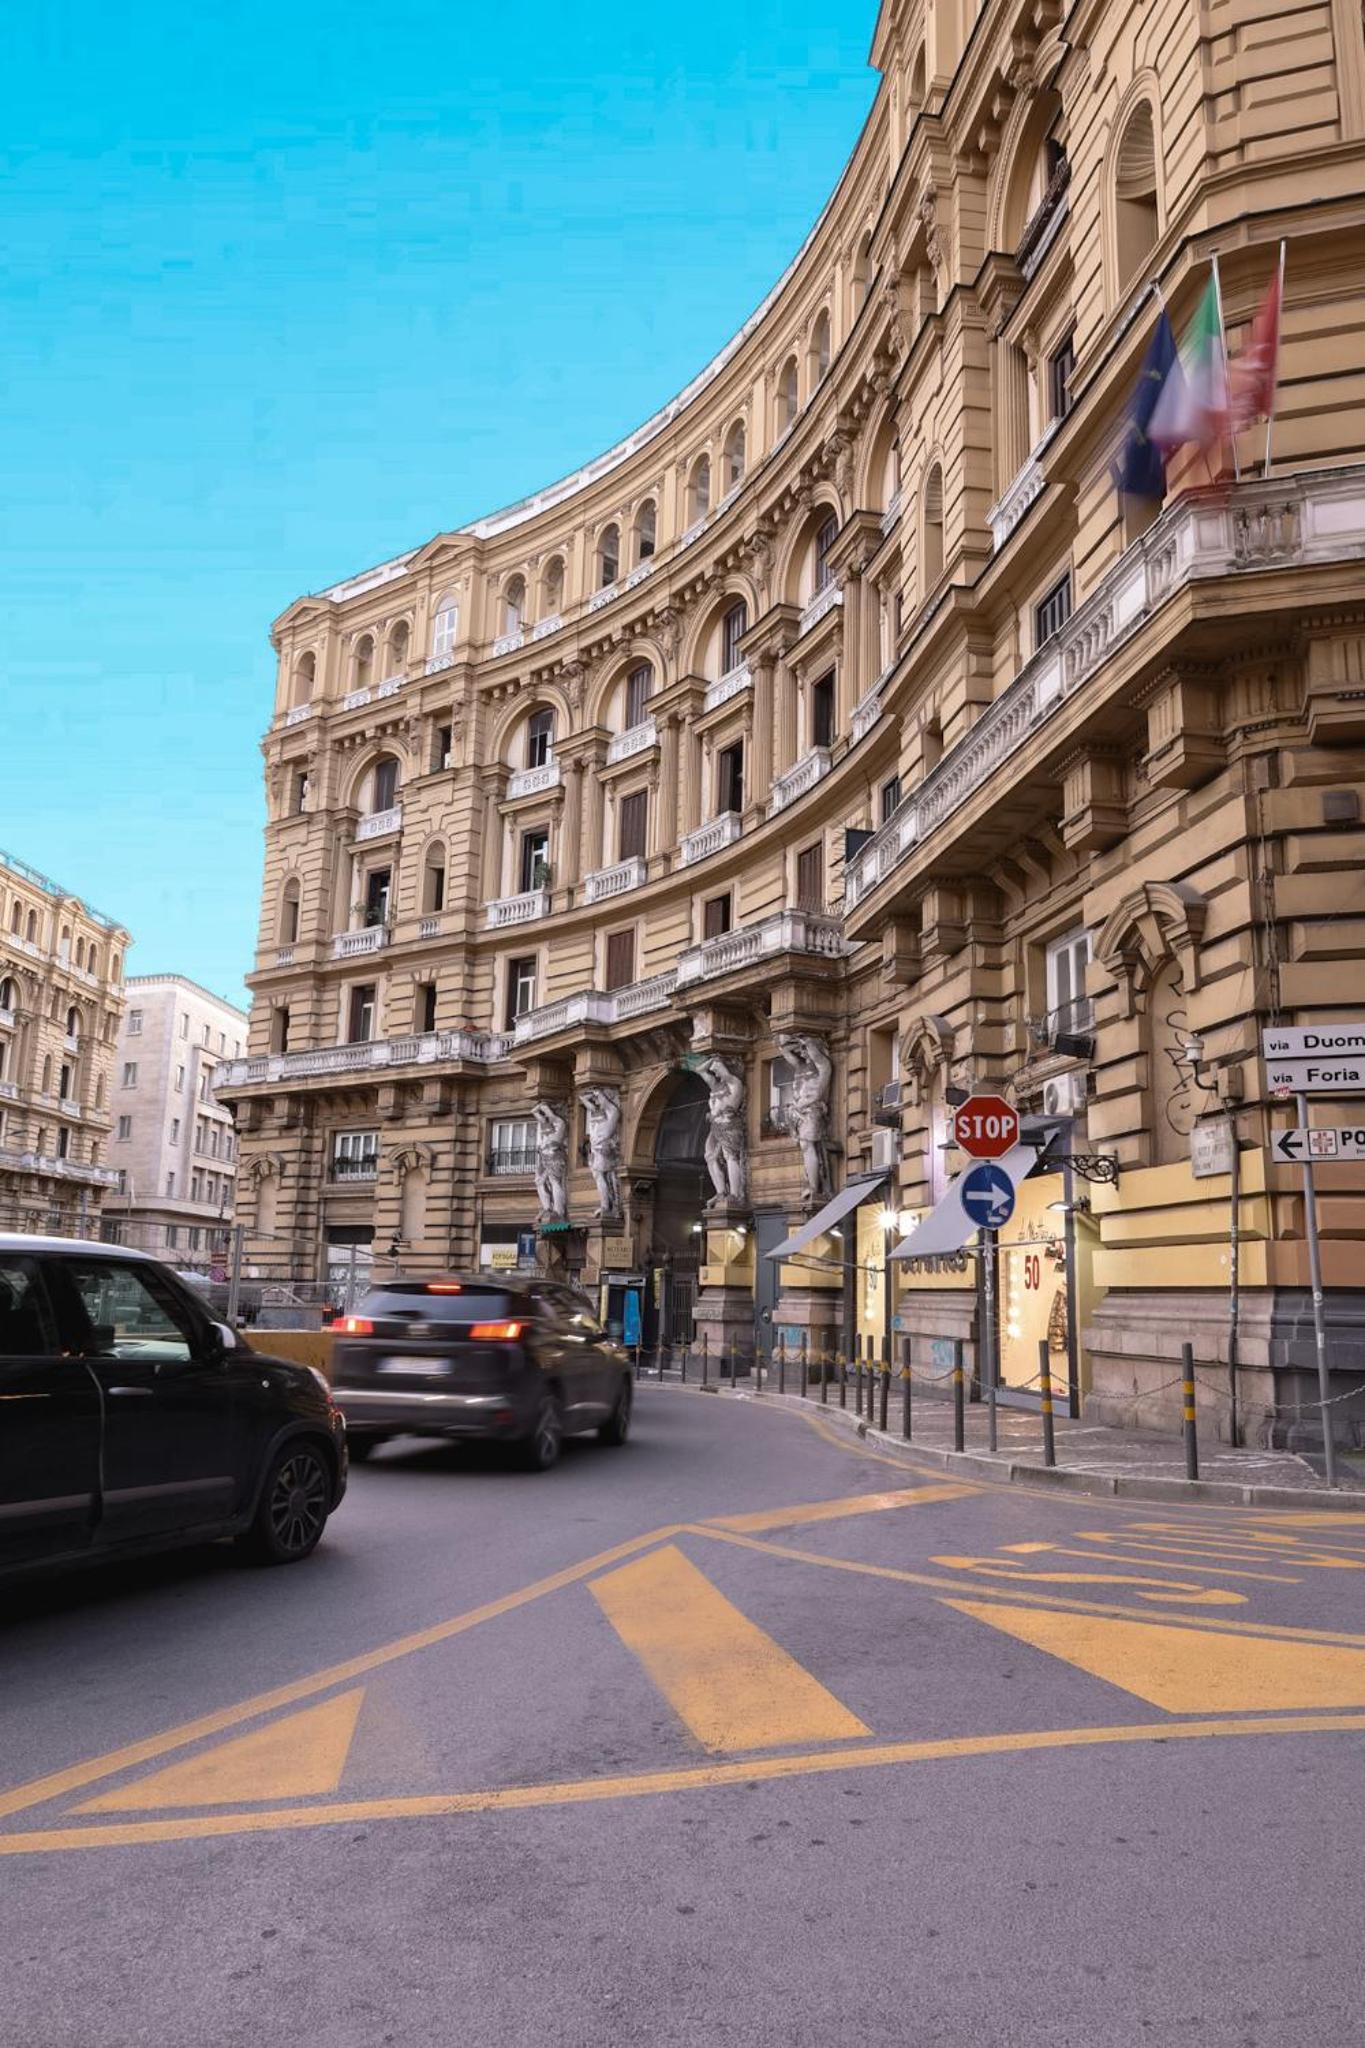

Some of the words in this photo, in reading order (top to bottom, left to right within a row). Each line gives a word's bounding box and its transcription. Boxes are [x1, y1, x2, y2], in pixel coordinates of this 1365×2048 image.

[1269, 1039, 1290, 1051] via
[1272, 1074, 1293, 1084] via
[1306, 1067, 1360, 1083] Foria
[957, 1115, 1016, 1139] STOP
[1024, 1255, 1040, 1291] 50
